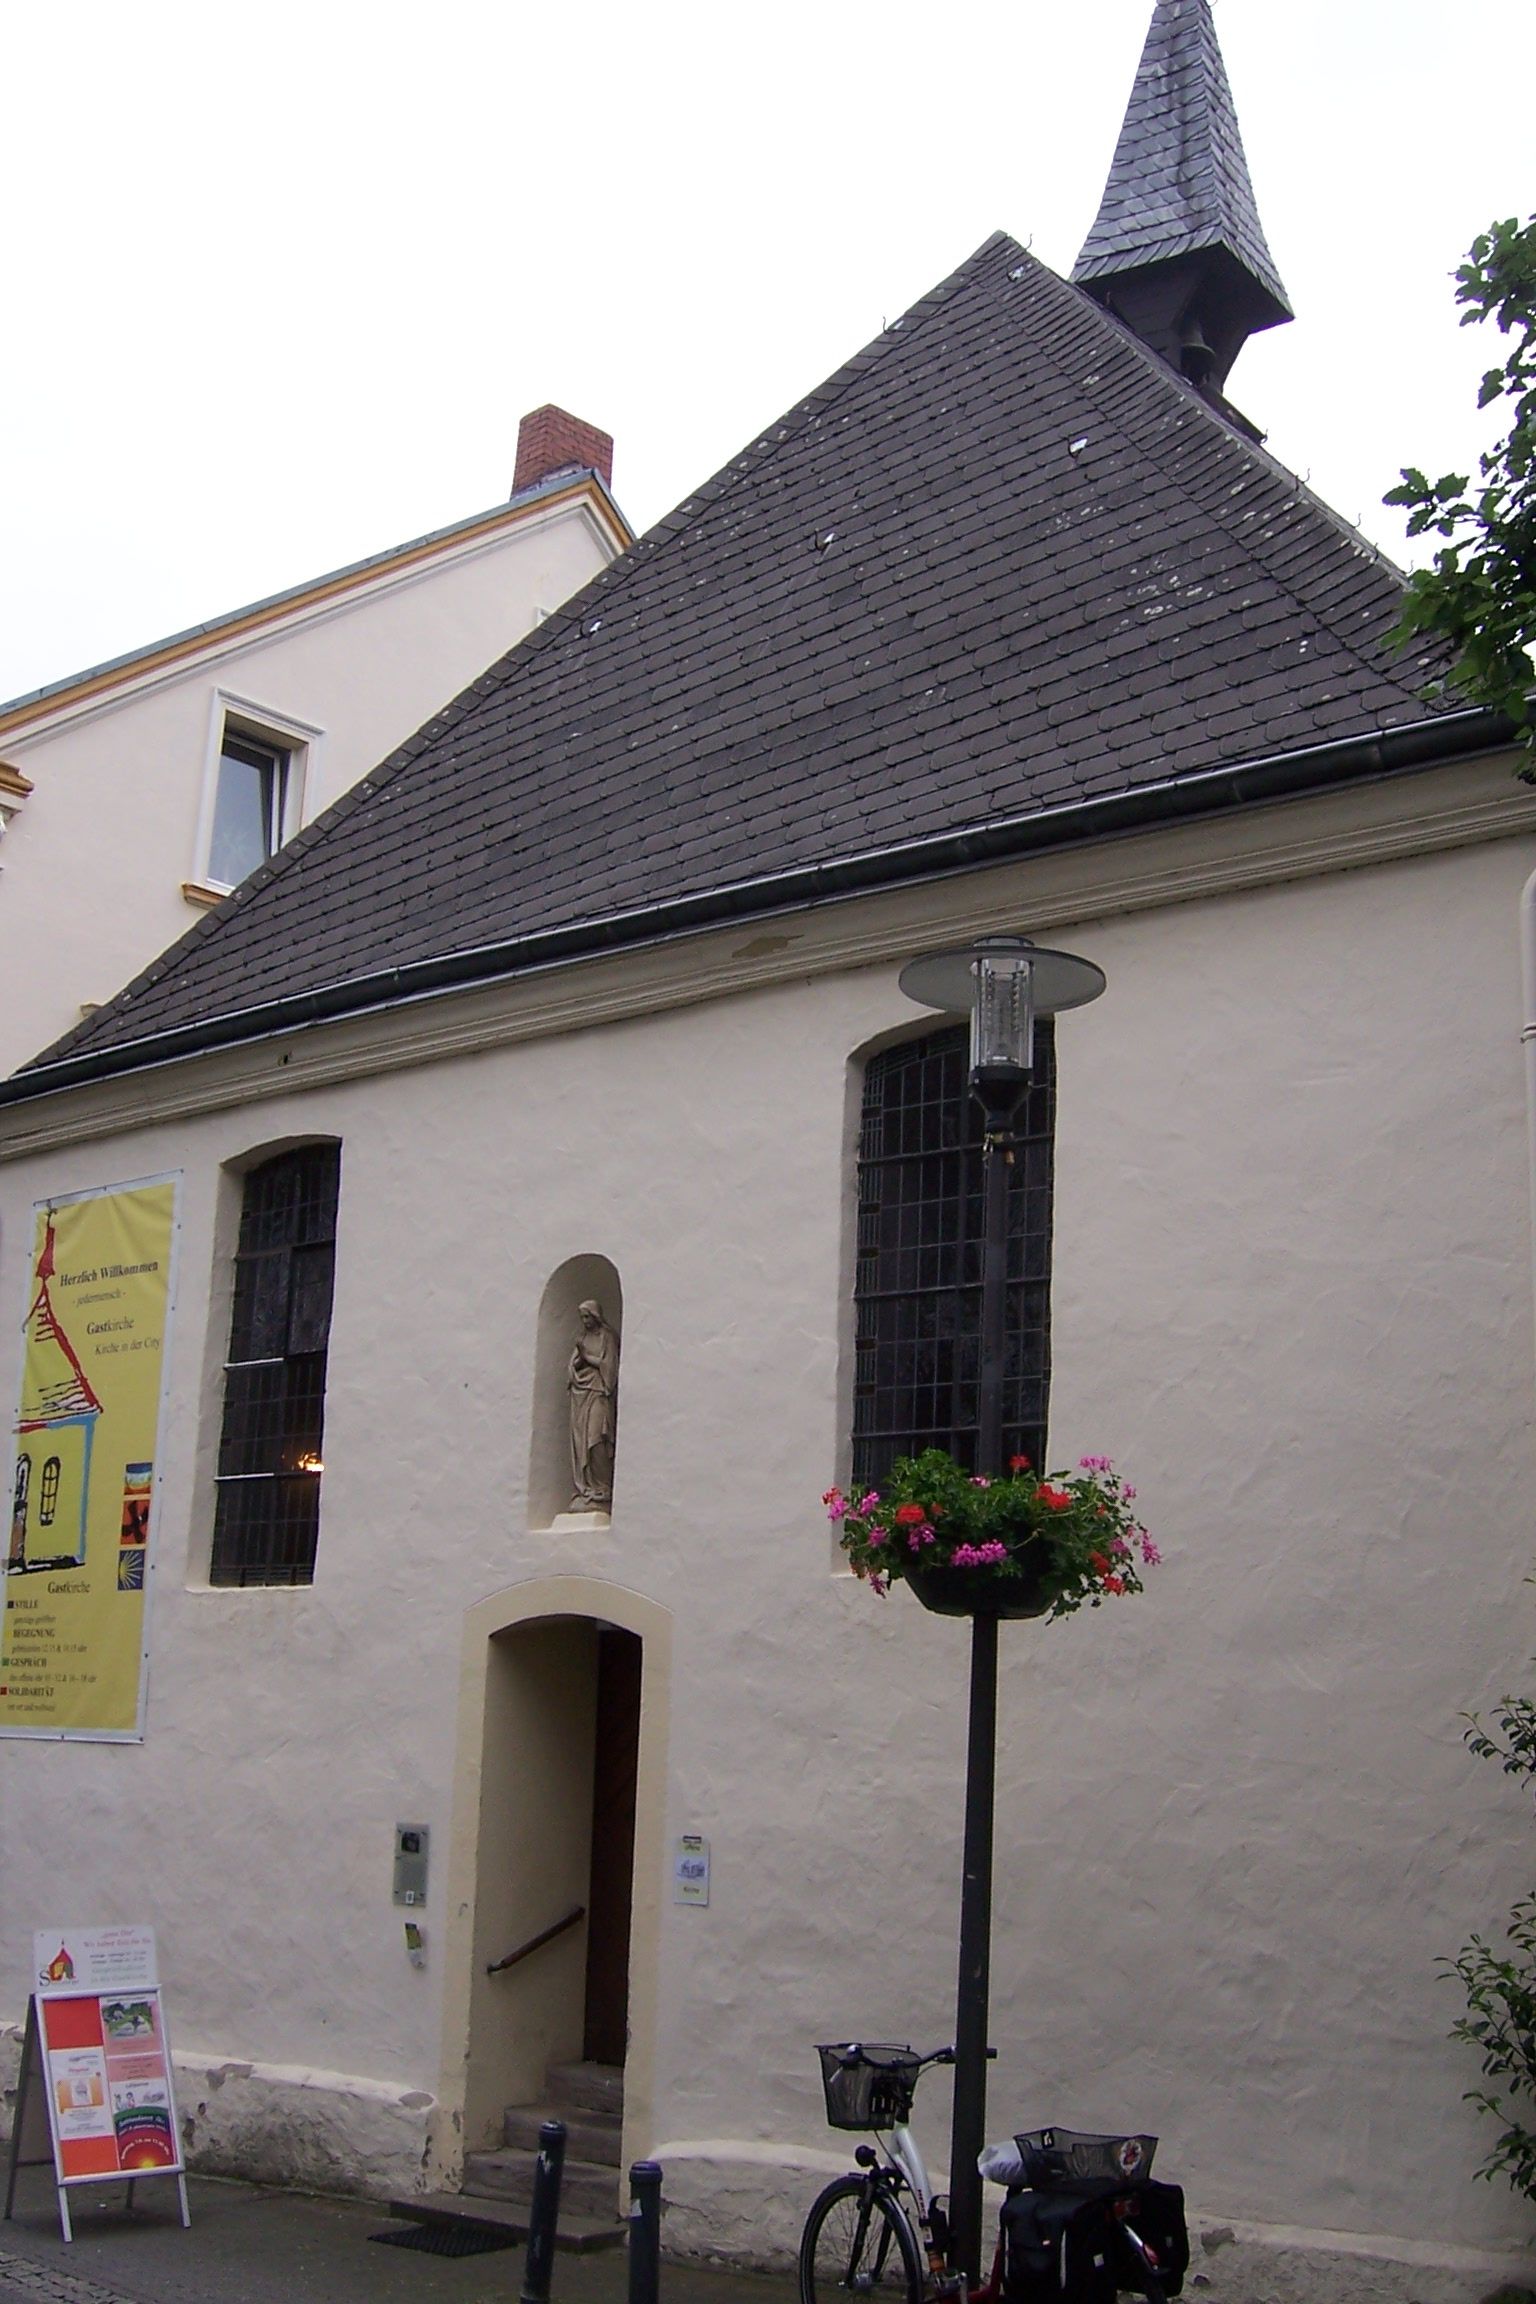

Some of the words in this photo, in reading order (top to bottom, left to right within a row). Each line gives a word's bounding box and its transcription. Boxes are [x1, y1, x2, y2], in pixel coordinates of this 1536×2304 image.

[59, 1269, 97, 1287] Herzlich
[100, 1261, 159, 1279] Willkommen
[86, 1316, 135, 1335] Gastkirche
